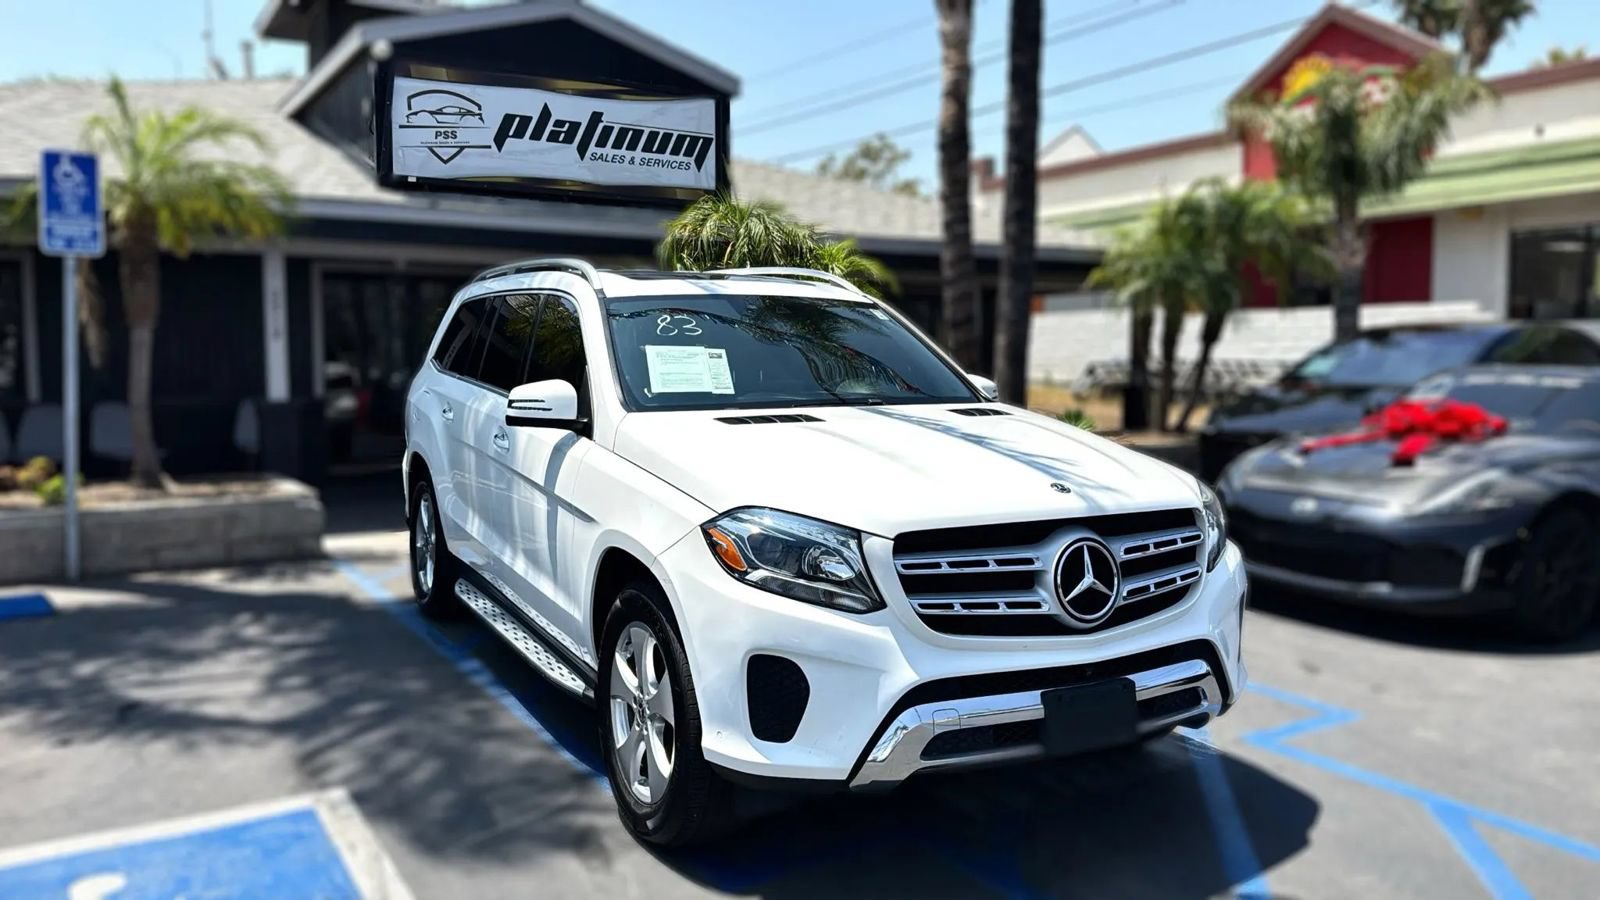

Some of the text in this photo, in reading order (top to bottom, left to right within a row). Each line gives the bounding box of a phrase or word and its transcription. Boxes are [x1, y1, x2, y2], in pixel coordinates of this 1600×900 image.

[434, 130, 458, 140] PSS
[493, 102, 714, 173] platinum
[589, 152, 692, 171] SALES & SERVICES
[656, 314, 703, 336] 83
